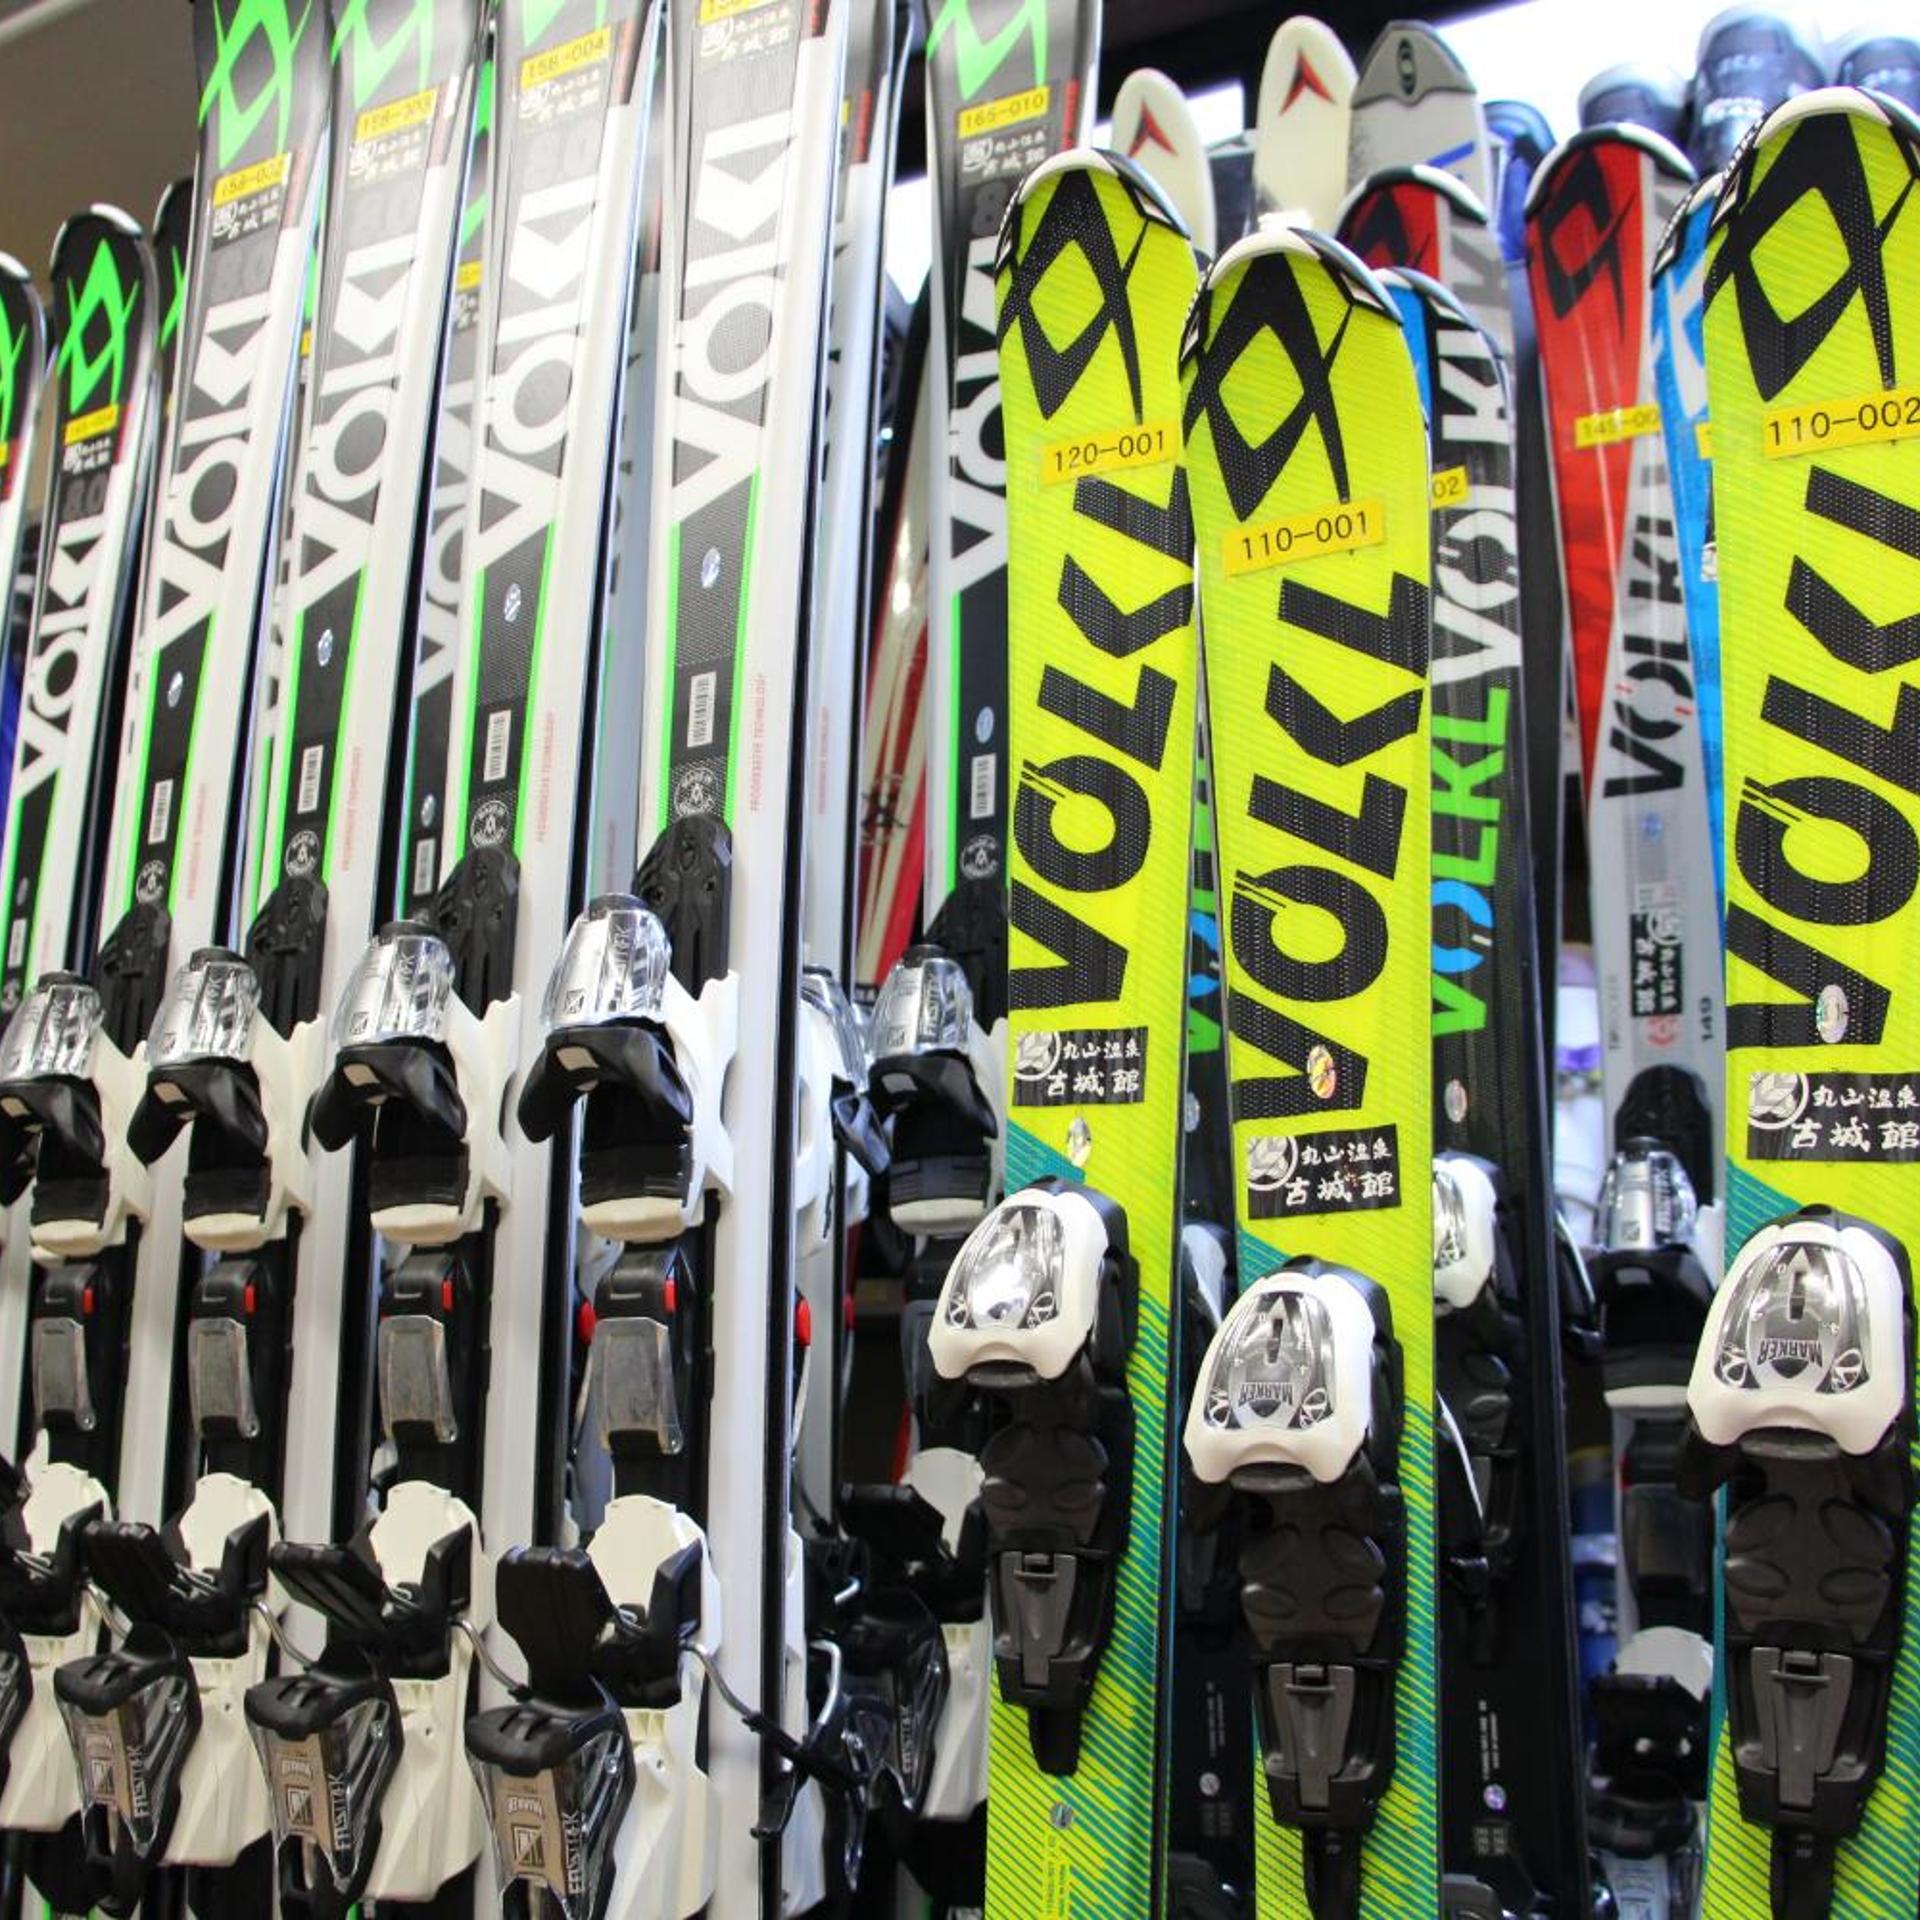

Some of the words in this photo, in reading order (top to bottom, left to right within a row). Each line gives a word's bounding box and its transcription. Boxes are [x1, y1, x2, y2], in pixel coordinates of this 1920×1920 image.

[965, 93, 1044, 128] 165-010
[1768, 401, 1920, 447] 110-002
[1053, 429, 1166, 472] 120-001
[1240, 512, 1368, 561] 110-001
[1063, 1037, 1141, 1060] 丸山温泉
[1812, 1083, 1920, 1109] 丸山温泉
[1301, 1138, 1391, 1167] 丸山温泉
[1757, 1339, 1823, 1368] MARKER
[1239, 1382, 1294, 1407] MARKER
